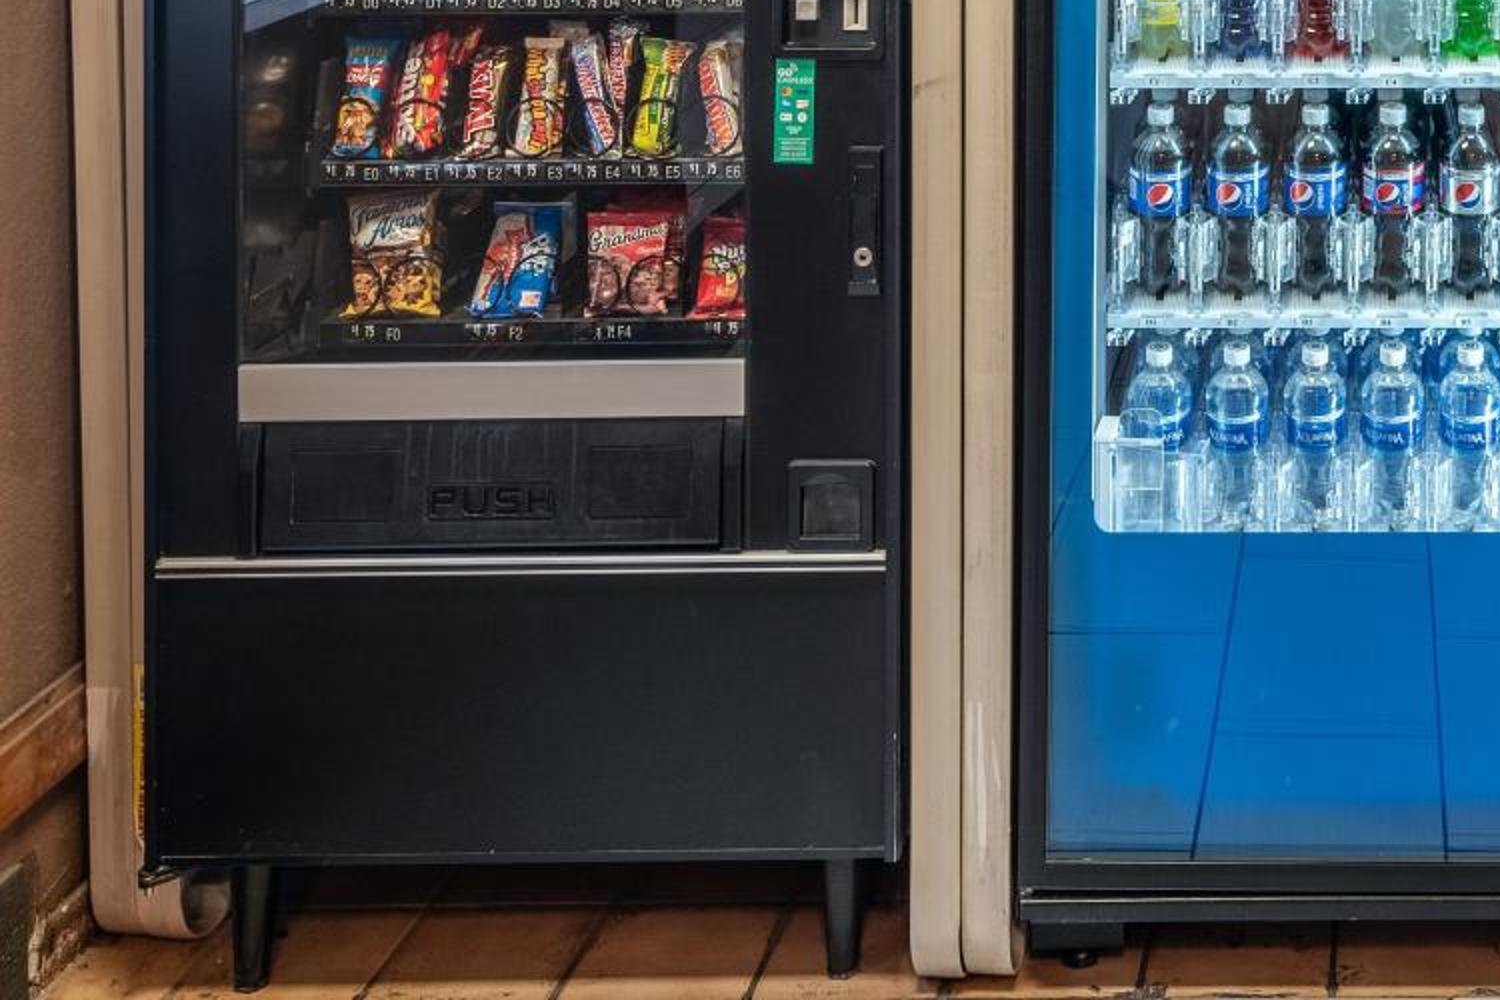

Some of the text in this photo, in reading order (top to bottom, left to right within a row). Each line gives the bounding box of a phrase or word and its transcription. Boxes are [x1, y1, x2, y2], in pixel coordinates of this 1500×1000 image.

[547, 168, 563, 180] E3
[605, 168, 620, 180] E4
[665, 167, 681, 179] E5
[725, 167, 741, 179] E6
[430, 488, 553, 517] PUSH
